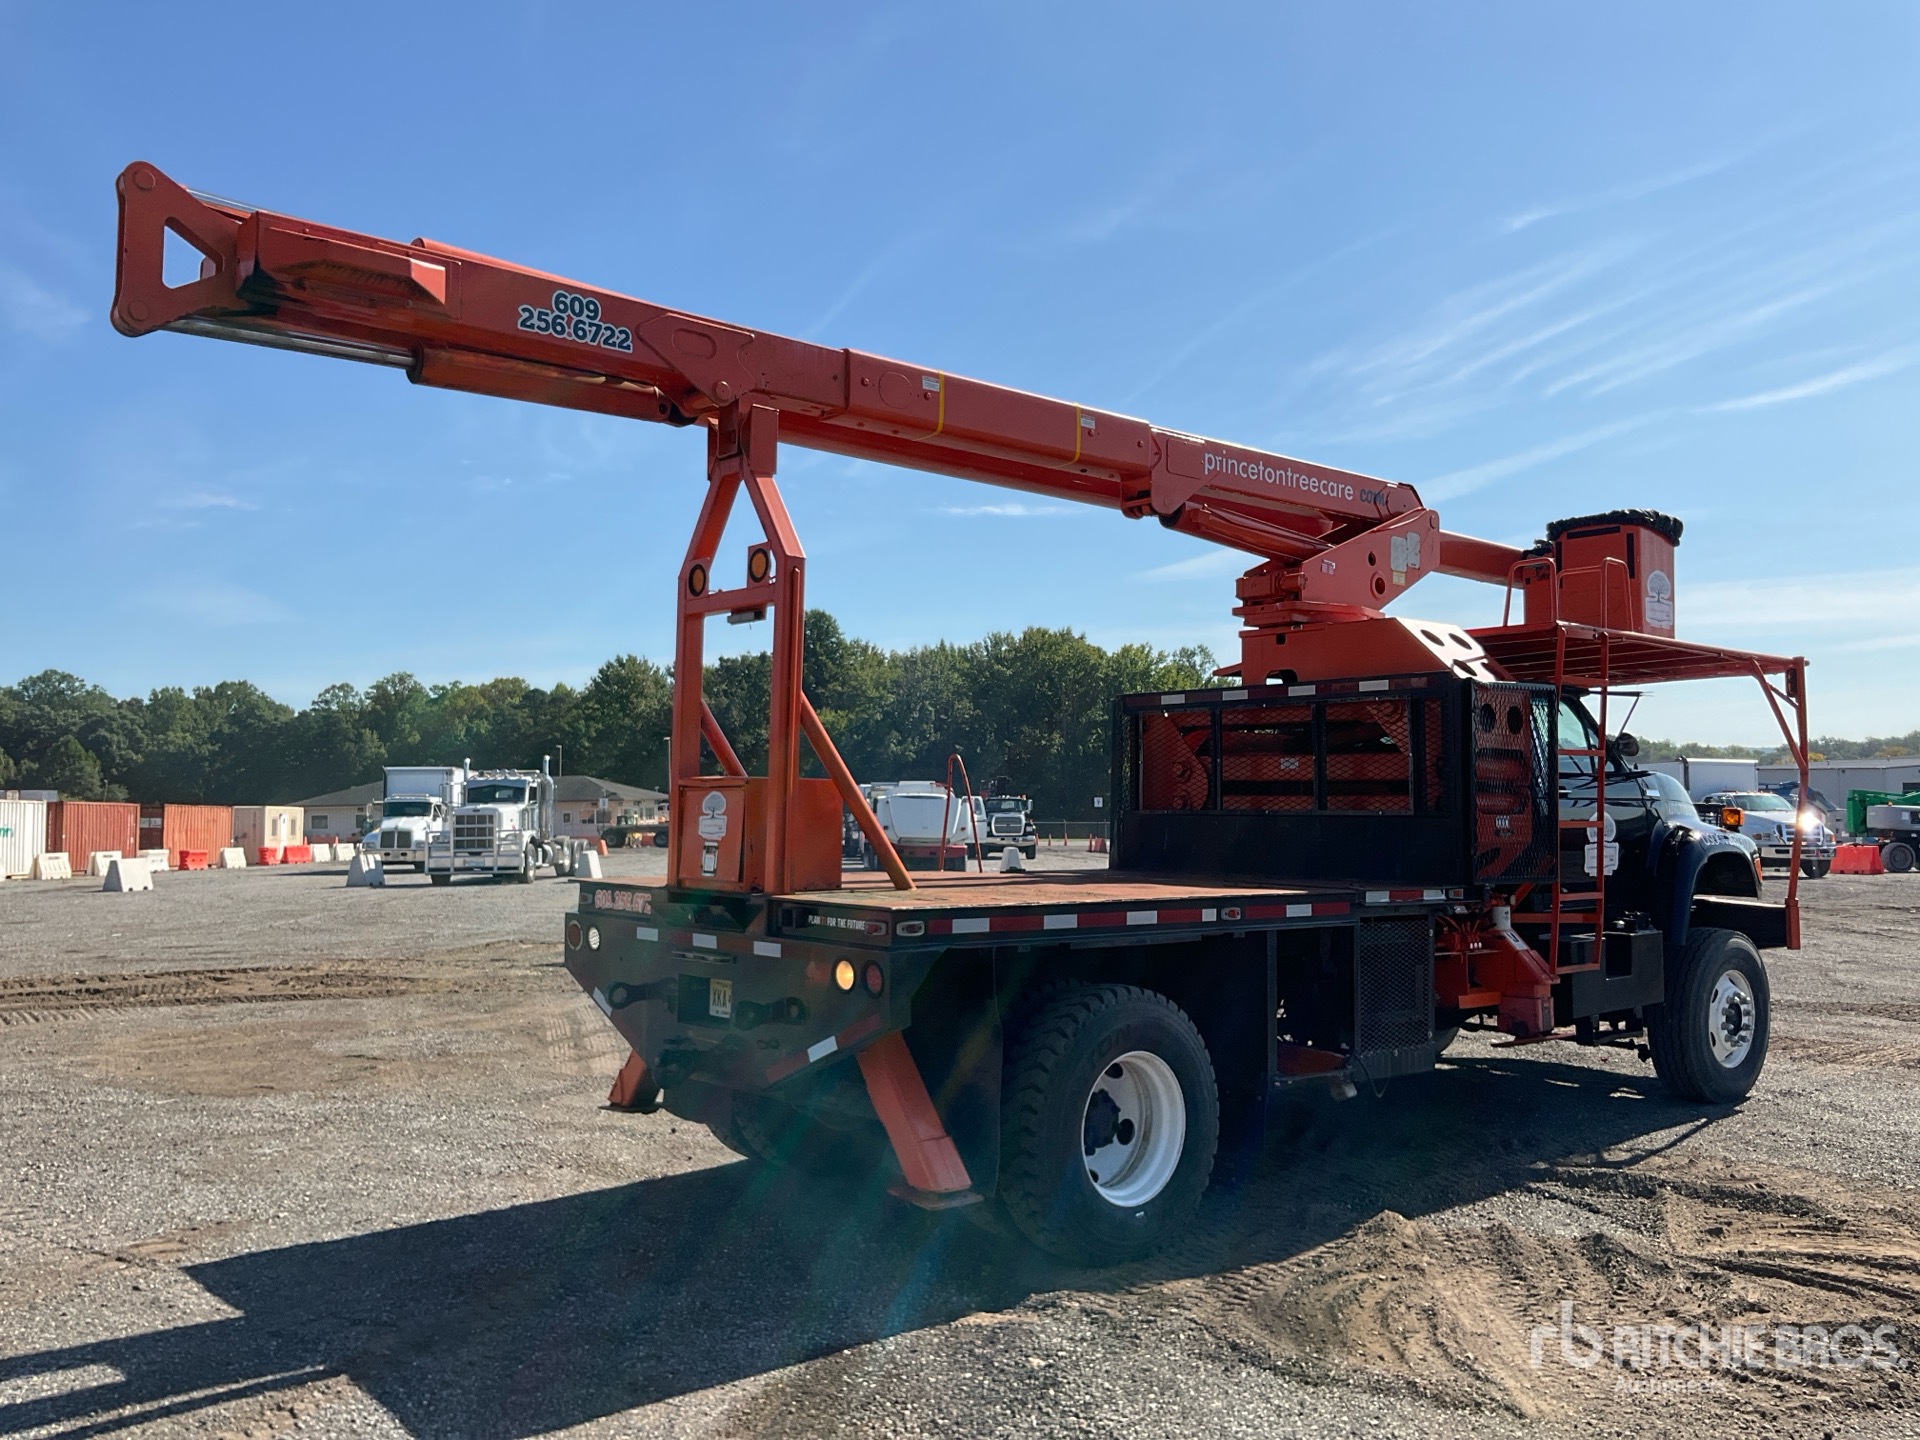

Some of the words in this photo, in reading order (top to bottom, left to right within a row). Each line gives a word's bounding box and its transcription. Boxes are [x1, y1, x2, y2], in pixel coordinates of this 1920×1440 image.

[552, 290, 601, 322] 609
[518, 304, 632, 353] 256.6722
[1204, 450, 1354, 500] princetontreecare
[827, 916, 837, 927] FOR
[837, 917, 847, 929] THE
[847, 919, 866, 931] FUTURE
